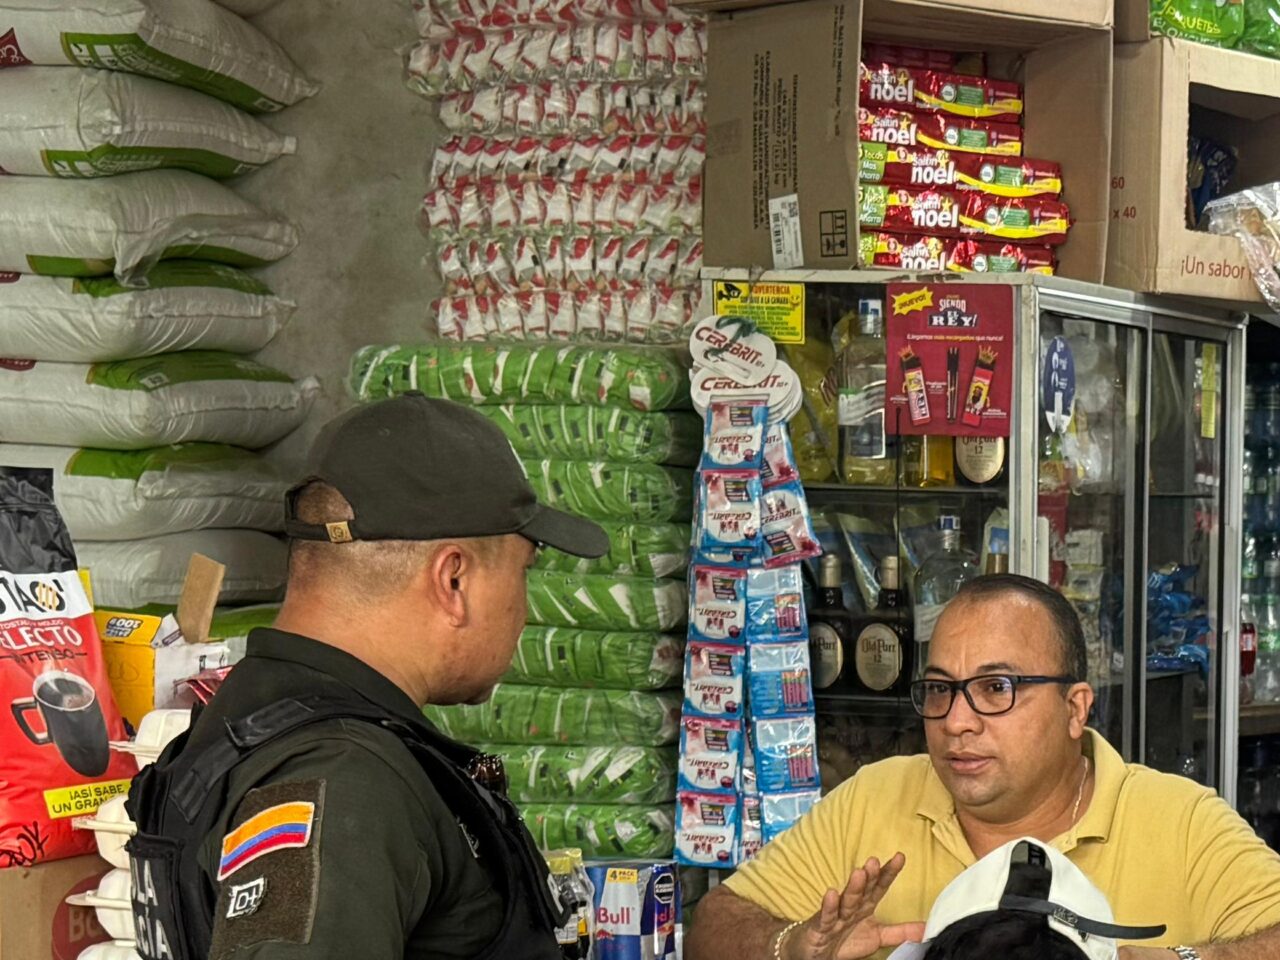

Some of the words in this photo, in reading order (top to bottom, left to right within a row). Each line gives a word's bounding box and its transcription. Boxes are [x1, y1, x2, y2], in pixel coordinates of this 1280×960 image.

[870, 80, 914, 103] noel
[871, 123, 917, 146] noel
[911, 161, 955, 185] noel
[1111, 177, 1125, 190] 60
[911, 204, 959, 228] noel
[1122, 206, 1136, 219] 40
[902, 251, 946, 270] noel
[1180, 256, 1204, 277] ¡Un
[1207, 259, 1245, 279] sabor
[939, 299, 966, 313] SIENDO
[932, 314, 978, 327] REY!
[14, 649, 76, 666] INTENSO
[94, 783, 125, 797] SABE
[52, 801, 72, 815] UN
[610, 870, 617, 880] 4
[597, 906, 631, 925] Bull
